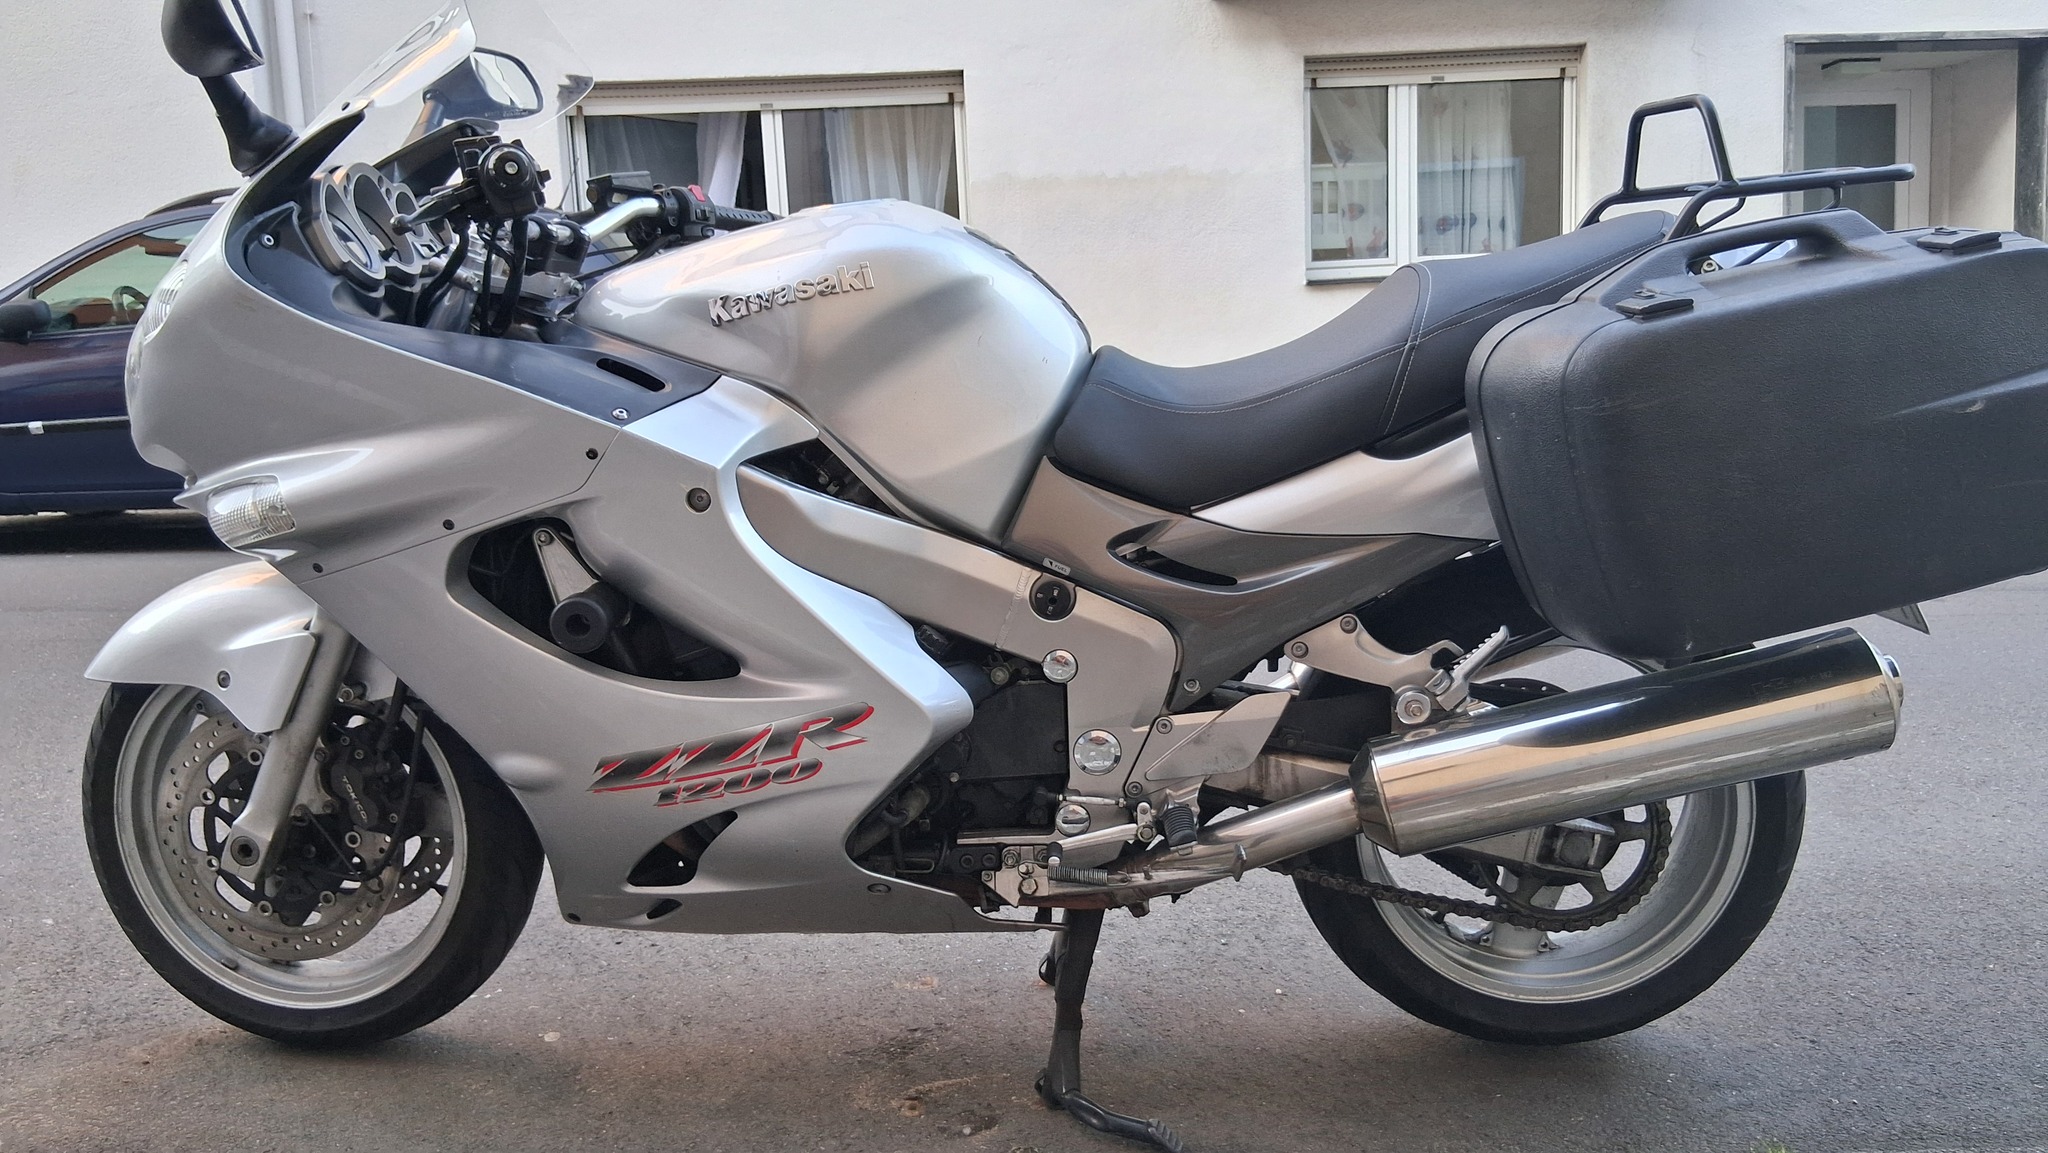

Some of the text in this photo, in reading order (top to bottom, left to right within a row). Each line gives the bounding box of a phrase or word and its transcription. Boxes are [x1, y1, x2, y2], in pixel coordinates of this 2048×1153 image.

[708, 260, 875, 327] Kawasaki
[1054, 564, 1068, 574] FUEL
[586, 701, 875, 794] ZZR
[342, 775, 368, 820] TOKICO
[653, 757, 823, 807] 1200
